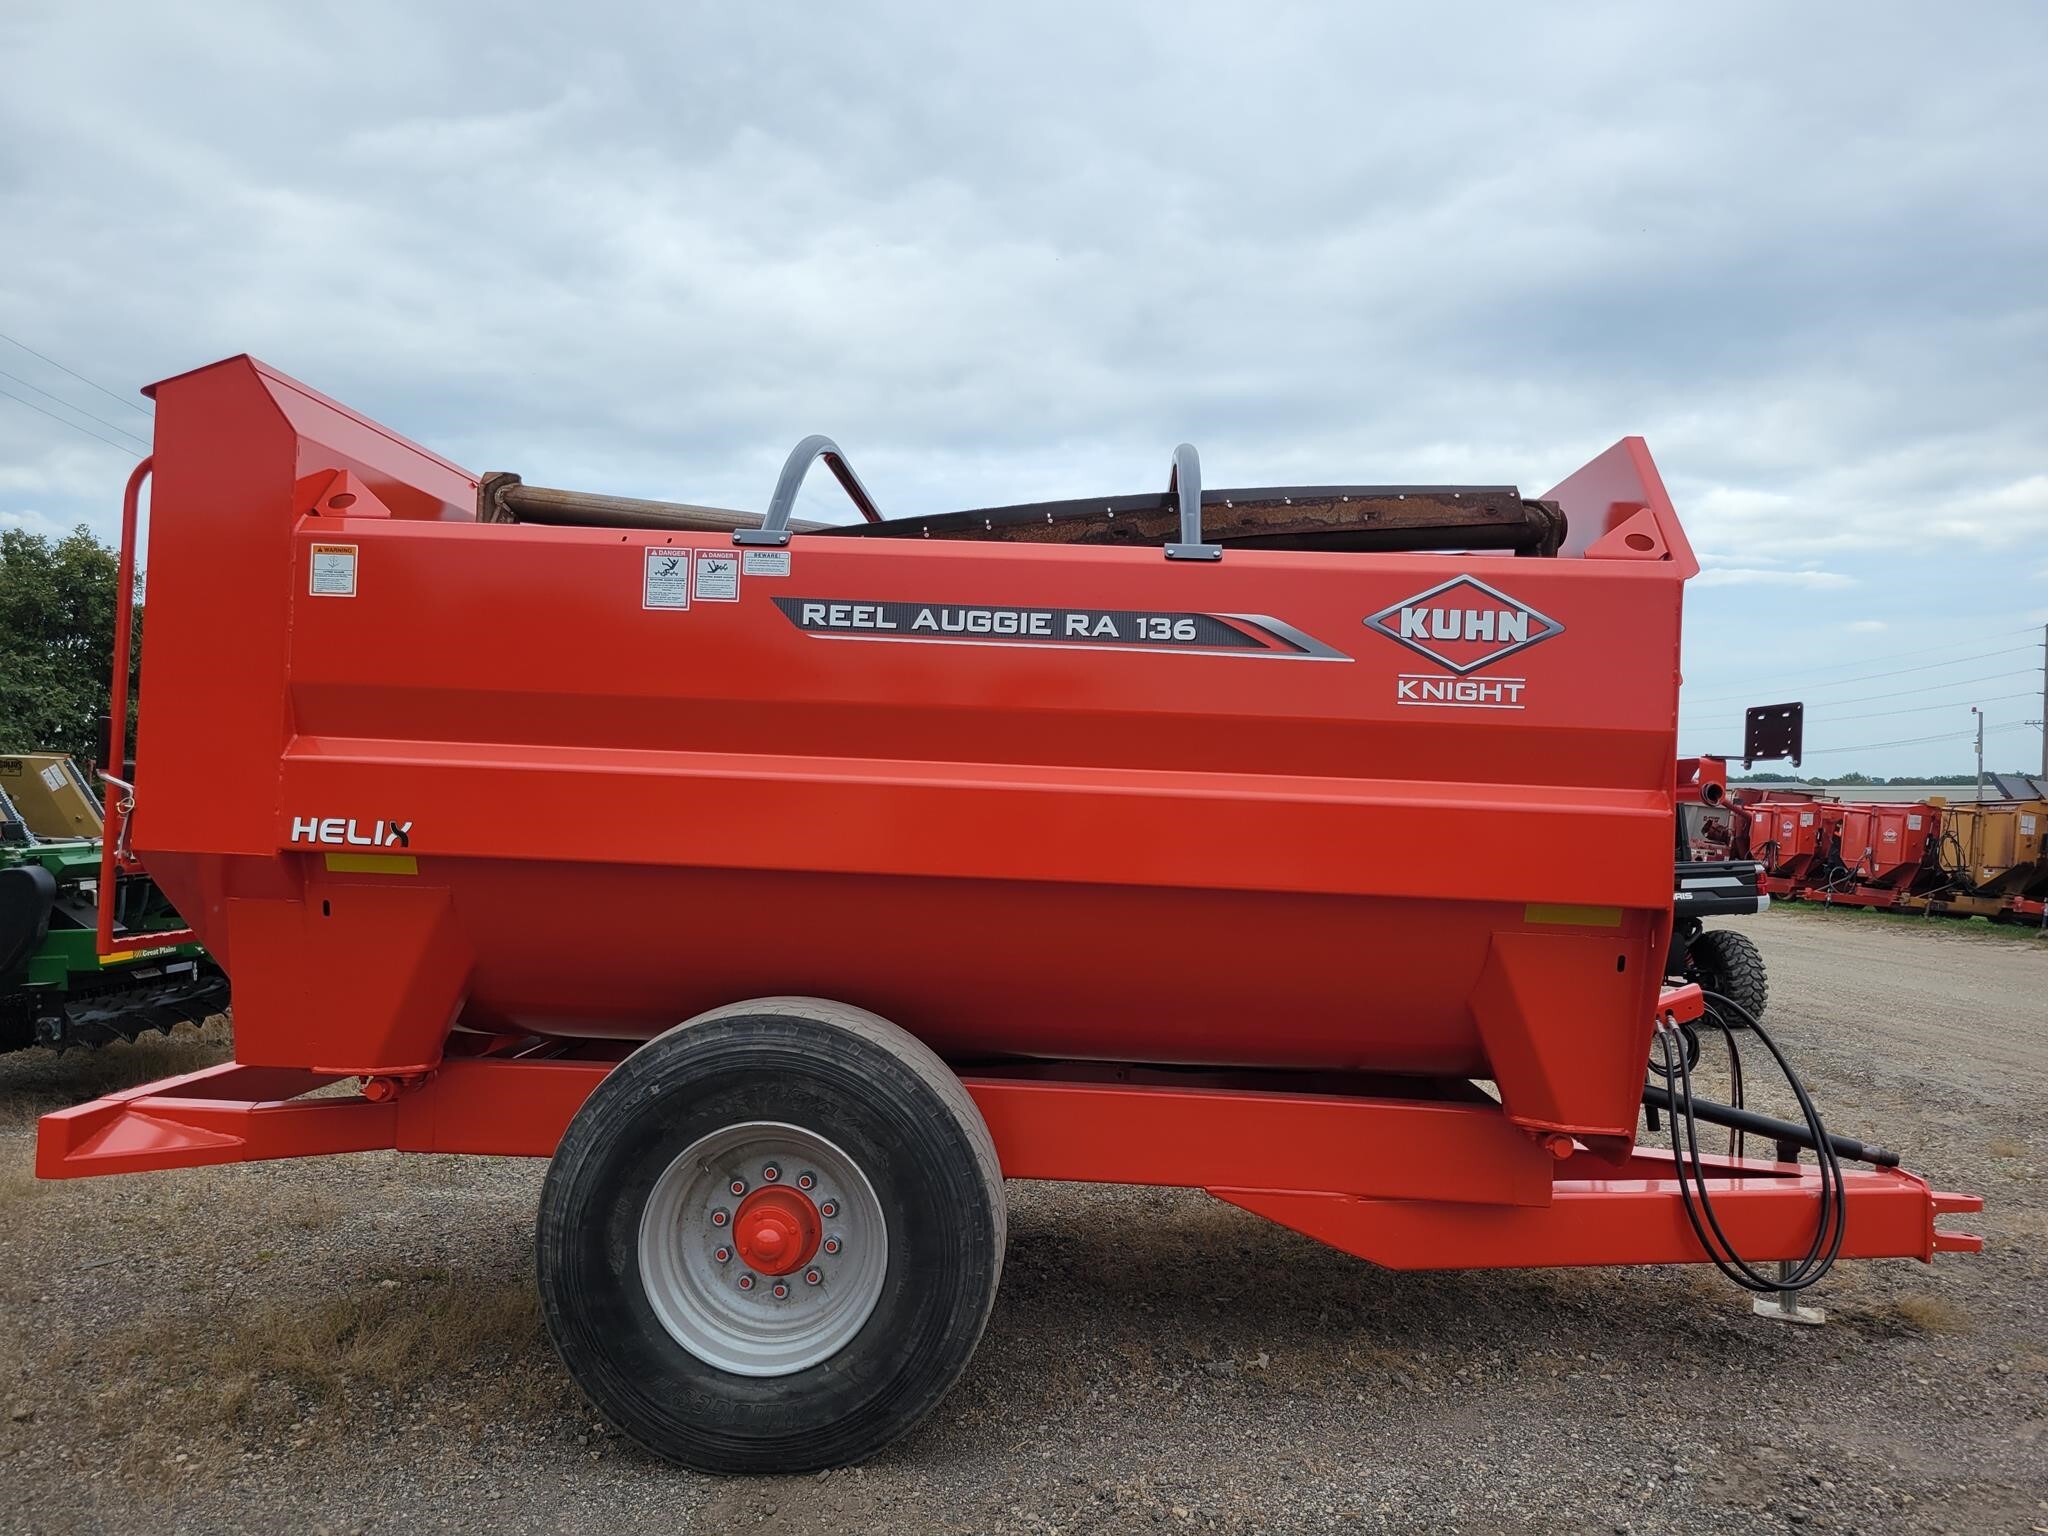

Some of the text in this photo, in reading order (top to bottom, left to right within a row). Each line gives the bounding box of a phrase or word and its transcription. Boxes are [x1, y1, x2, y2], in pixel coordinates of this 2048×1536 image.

[658, 549, 686, 557] DANGER
[802, 603, 1196, 641] REEL AUGGIE RA 136
[1400, 607, 1528, 643] KUHN
[1398, 680, 1525, 702] KNIGHT
[291, 816, 413, 848] HELIX
[143, 945, 177, 957] Great Plains
